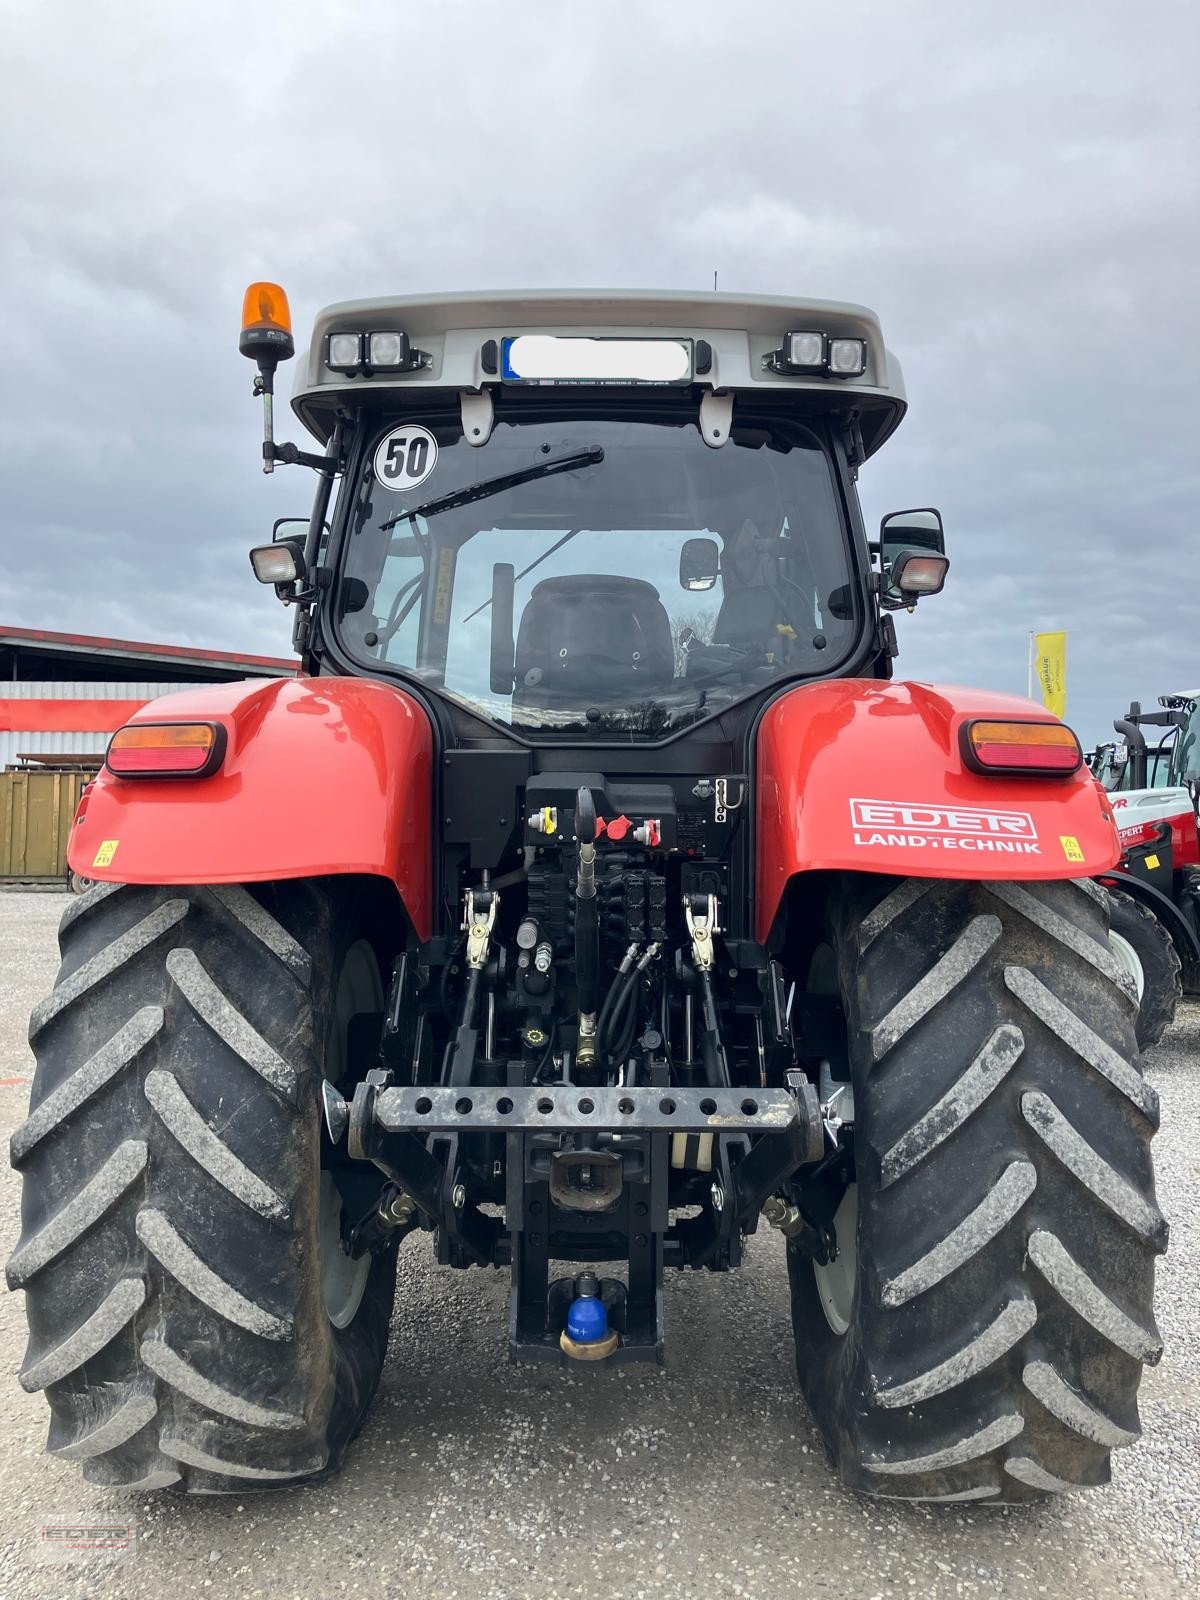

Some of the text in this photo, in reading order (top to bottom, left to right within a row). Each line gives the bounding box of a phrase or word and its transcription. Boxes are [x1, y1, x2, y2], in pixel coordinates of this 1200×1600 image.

[383, 436, 429, 479] 50
[857, 805, 1027, 832] EDER
[853, 833, 1042, 854] LANDTECHNIK
